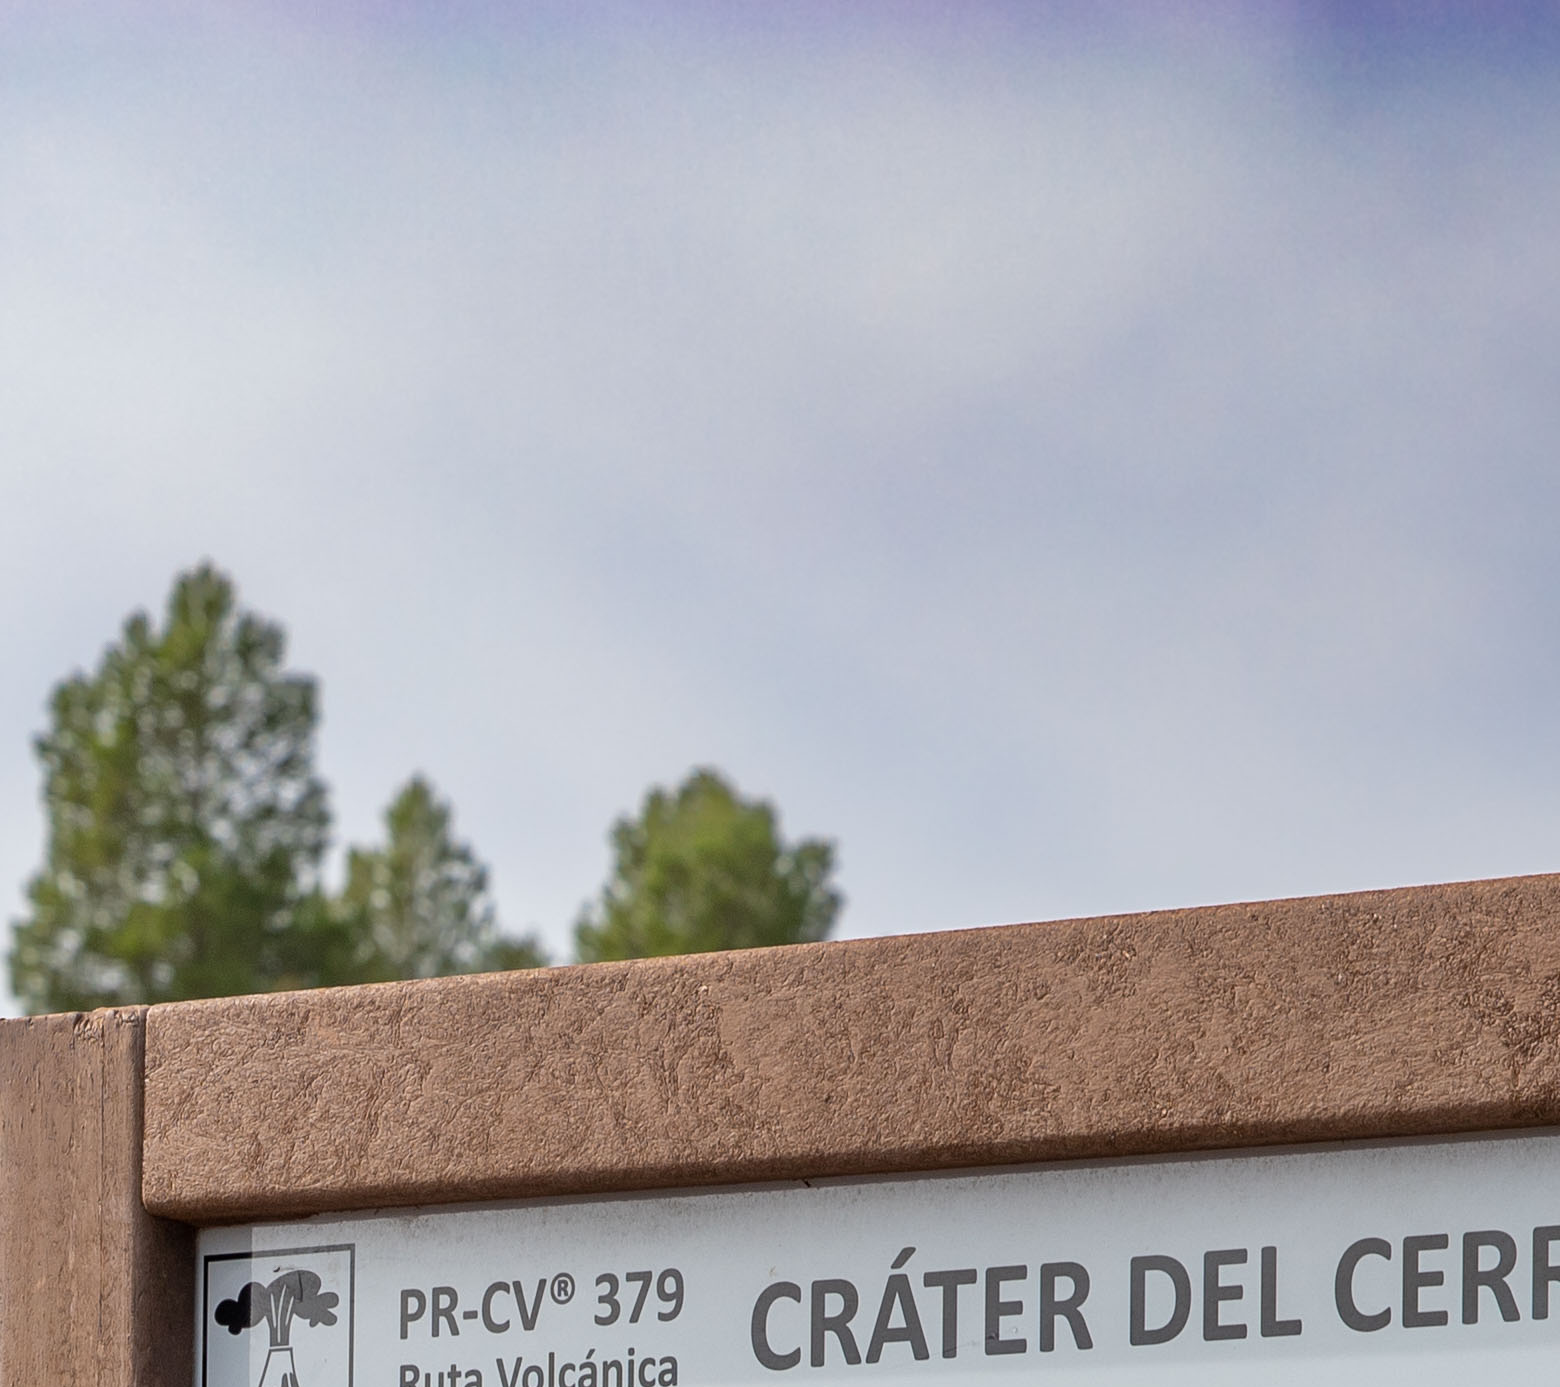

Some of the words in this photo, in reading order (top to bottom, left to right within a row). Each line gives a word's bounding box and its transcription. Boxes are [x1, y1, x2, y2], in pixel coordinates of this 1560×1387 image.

[594, 1268, 684, 1326] 379
[751, 1247, 1093, 1371] CRÁTER
[1130, 1246, 1302, 1346] DEL
